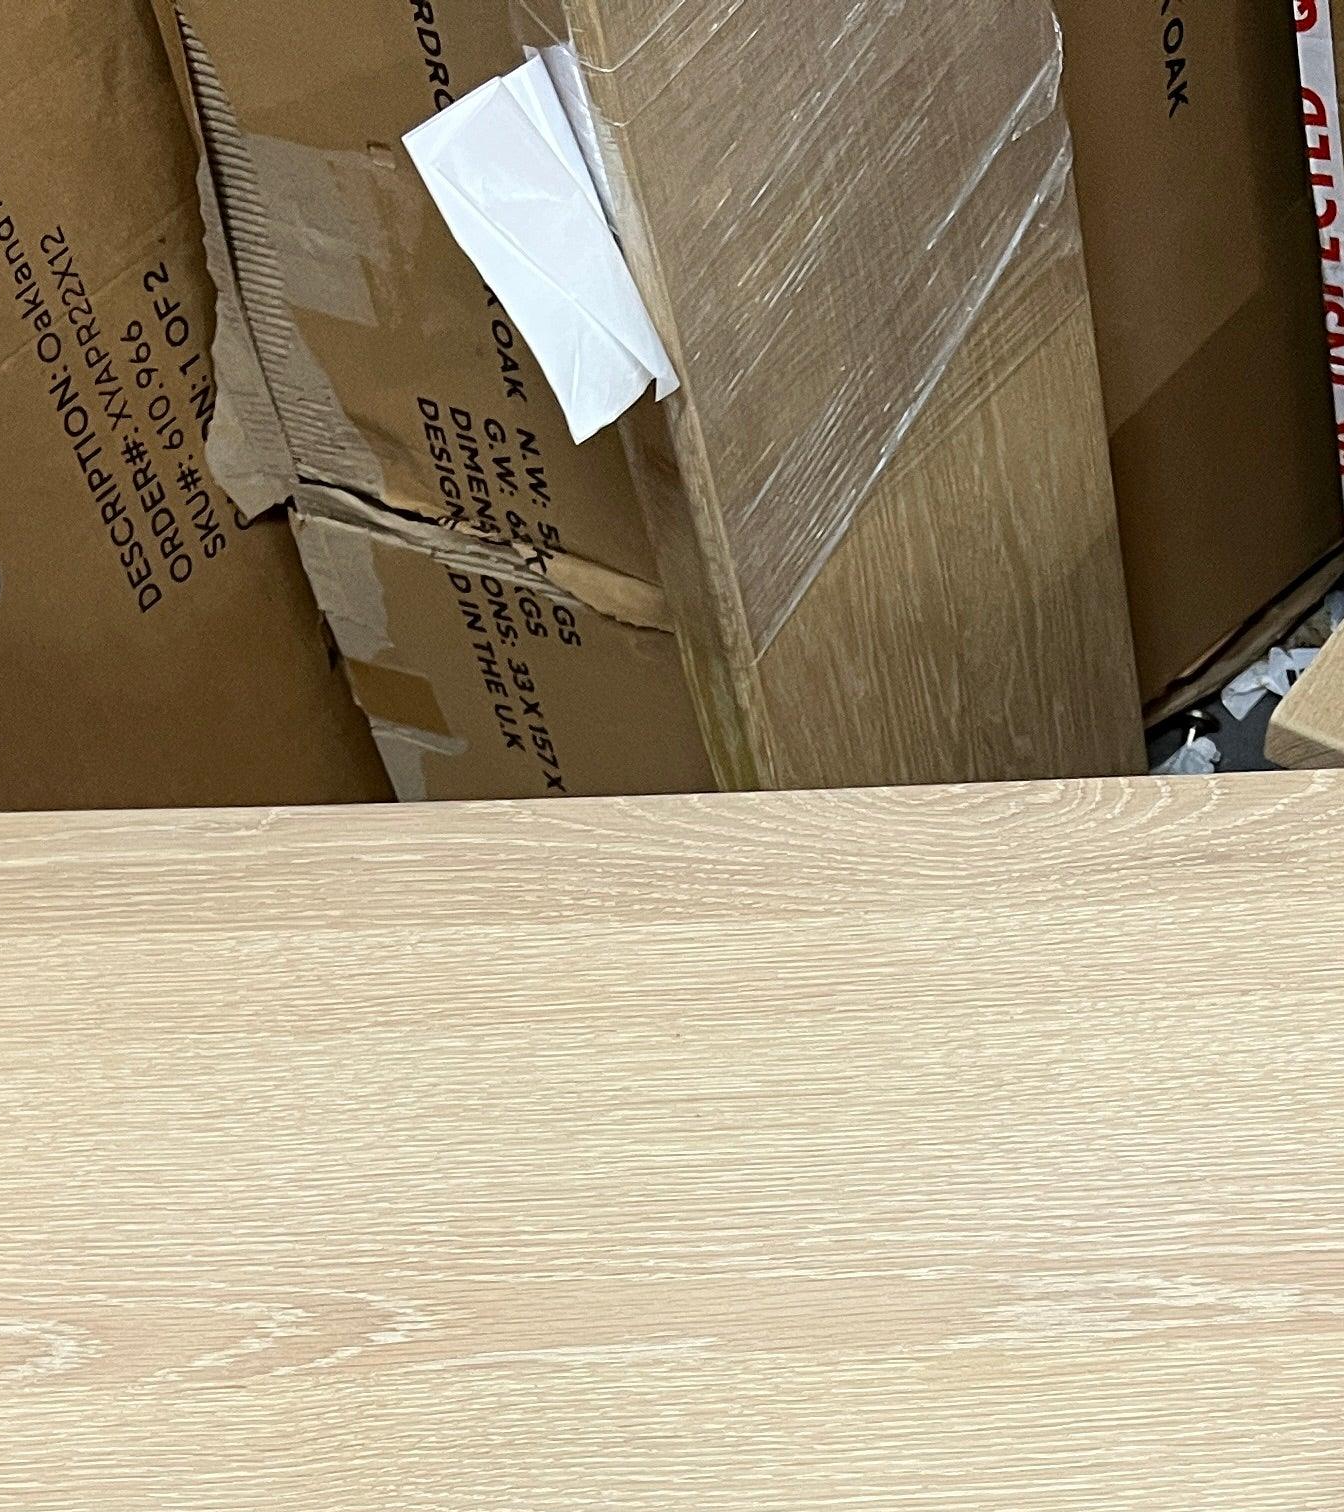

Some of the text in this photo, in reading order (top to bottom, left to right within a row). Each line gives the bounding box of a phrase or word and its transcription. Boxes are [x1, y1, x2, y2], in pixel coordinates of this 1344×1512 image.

[1162, 16, 1189, 119] OAK
[40, 225, 193, 584] ORDER#: XYAPR22X12
[120, 319, 185, 451] 610.966
[491, 318, 528, 402] OAK
[49, 364, 163, 613] DESCRIPTION:
[176, 453, 226, 560] SKU#:
[458, 599, 487, 633] IN
[473, 641, 508, 698] THE
